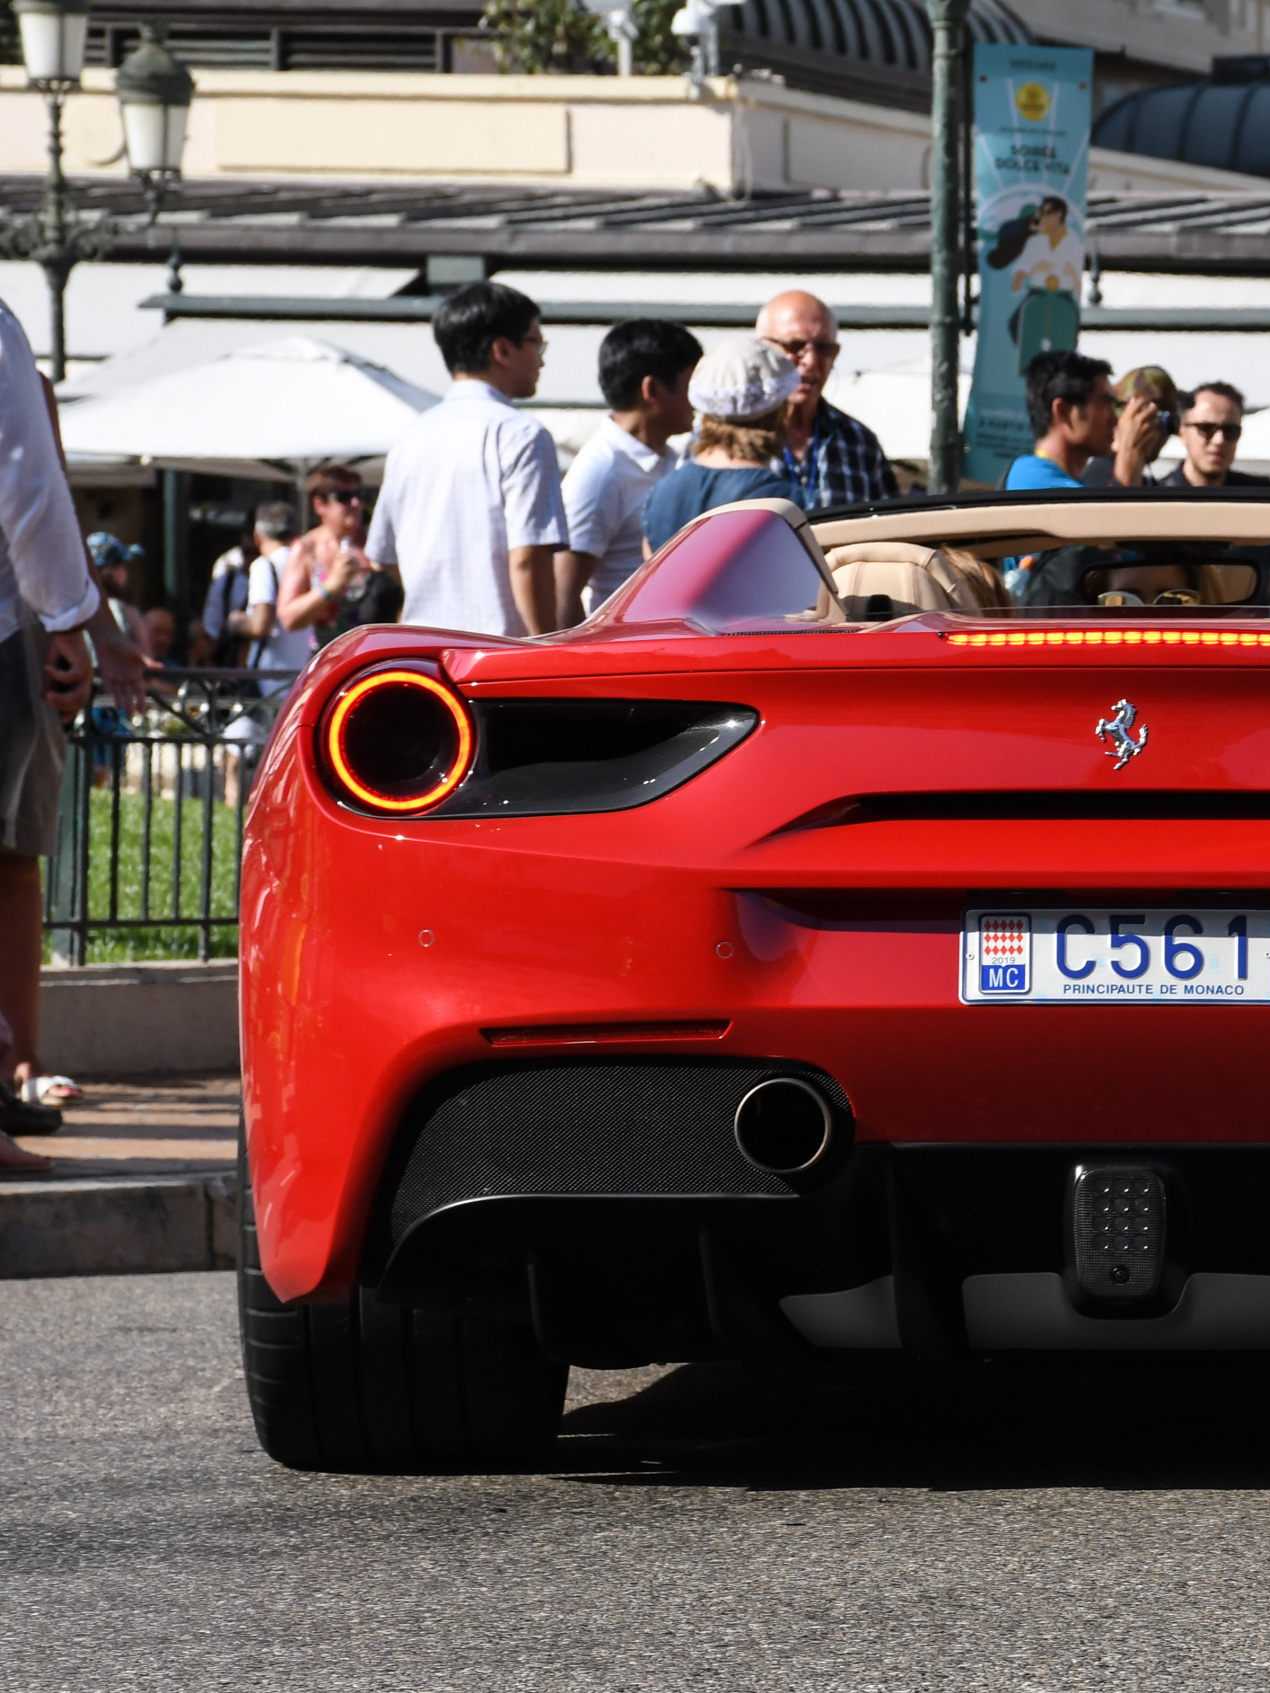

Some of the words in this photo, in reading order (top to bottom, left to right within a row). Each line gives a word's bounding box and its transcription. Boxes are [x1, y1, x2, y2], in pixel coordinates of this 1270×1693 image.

[1056, 914, 1249, 981] C561
[992, 956, 1016, 965] 2019
[988, 967, 1019, 988] MC
[1062, 983, 1154, 995] PRINCIPAUTE
[1159, 984, 1178, 995] DE
[1184, 984, 1246, 996] MONACO
